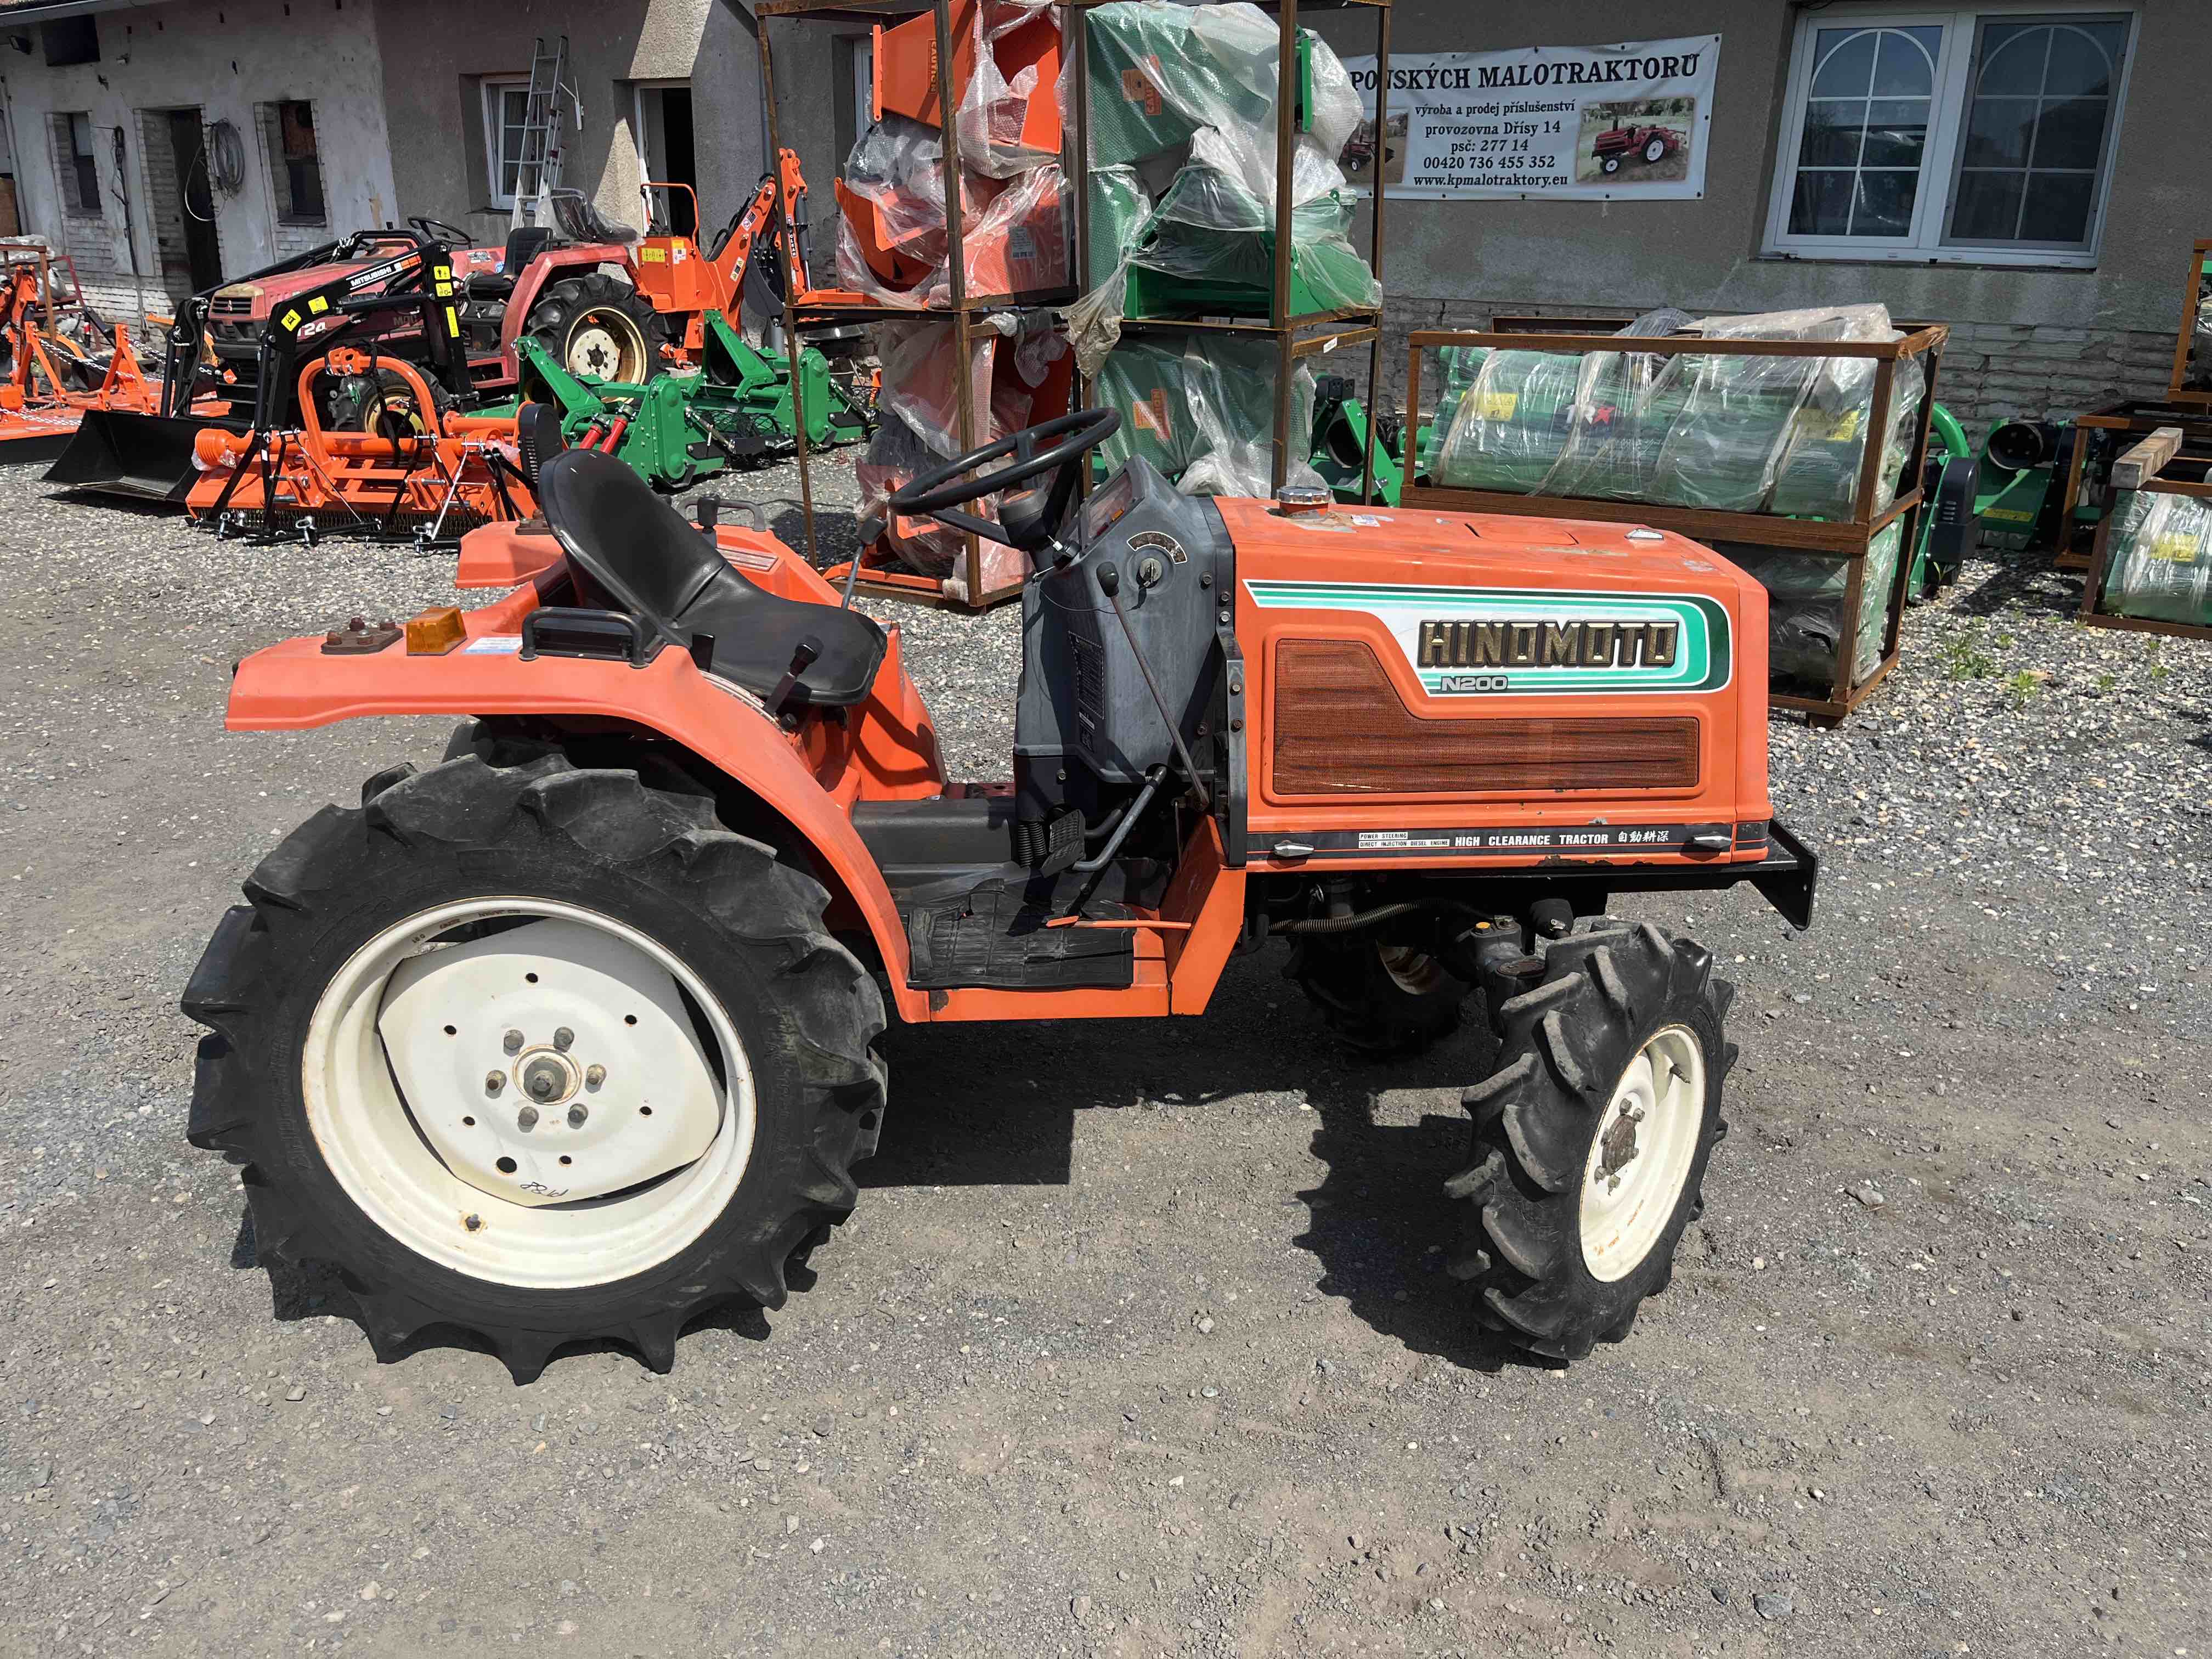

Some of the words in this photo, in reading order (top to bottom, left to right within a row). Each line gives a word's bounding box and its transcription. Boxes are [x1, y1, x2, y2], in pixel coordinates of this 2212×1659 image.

[1478, 54, 1700, 87] MALOTRAKTORŮ
[1415, 104, 1452, 117] výroba
[1456, 106, 1462, 114] a
[1466, 103, 1499, 117] prodej
[1503, 99, 1576, 116] příslušenství
[1425, 125, 1498, 138] provozovna
[1504, 121, 1538, 136] Dřísy
[1544, 121, 1560, 133] 14
[1451, 140, 1475, 154] psč:
[1481, 139, 1508, 151] 277
[1512, 139, 1528, 151] 14
[1424, 157, 1464, 169] 00420
[1469, 156, 1493, 168] 736
[1498, 156, 1523, 168] 455
[1529, 155, 1555, 168] 352
[1414, 173, 1568, 188] www.kpmalotraktory.eu
[351, 267, 392, 286] MITSUBISHI
[1418, 620, 1678, 668] HINOMOTO
[1441, 675, 1508, 691] N200
[1455, 837, 1480, 847] HIGH
[1488, 835, 1550, 846] CLEARANCE
[1560, 834, 1608, 845] TRACTOR
[1618, 830, 1668, 843] 自動耕深
